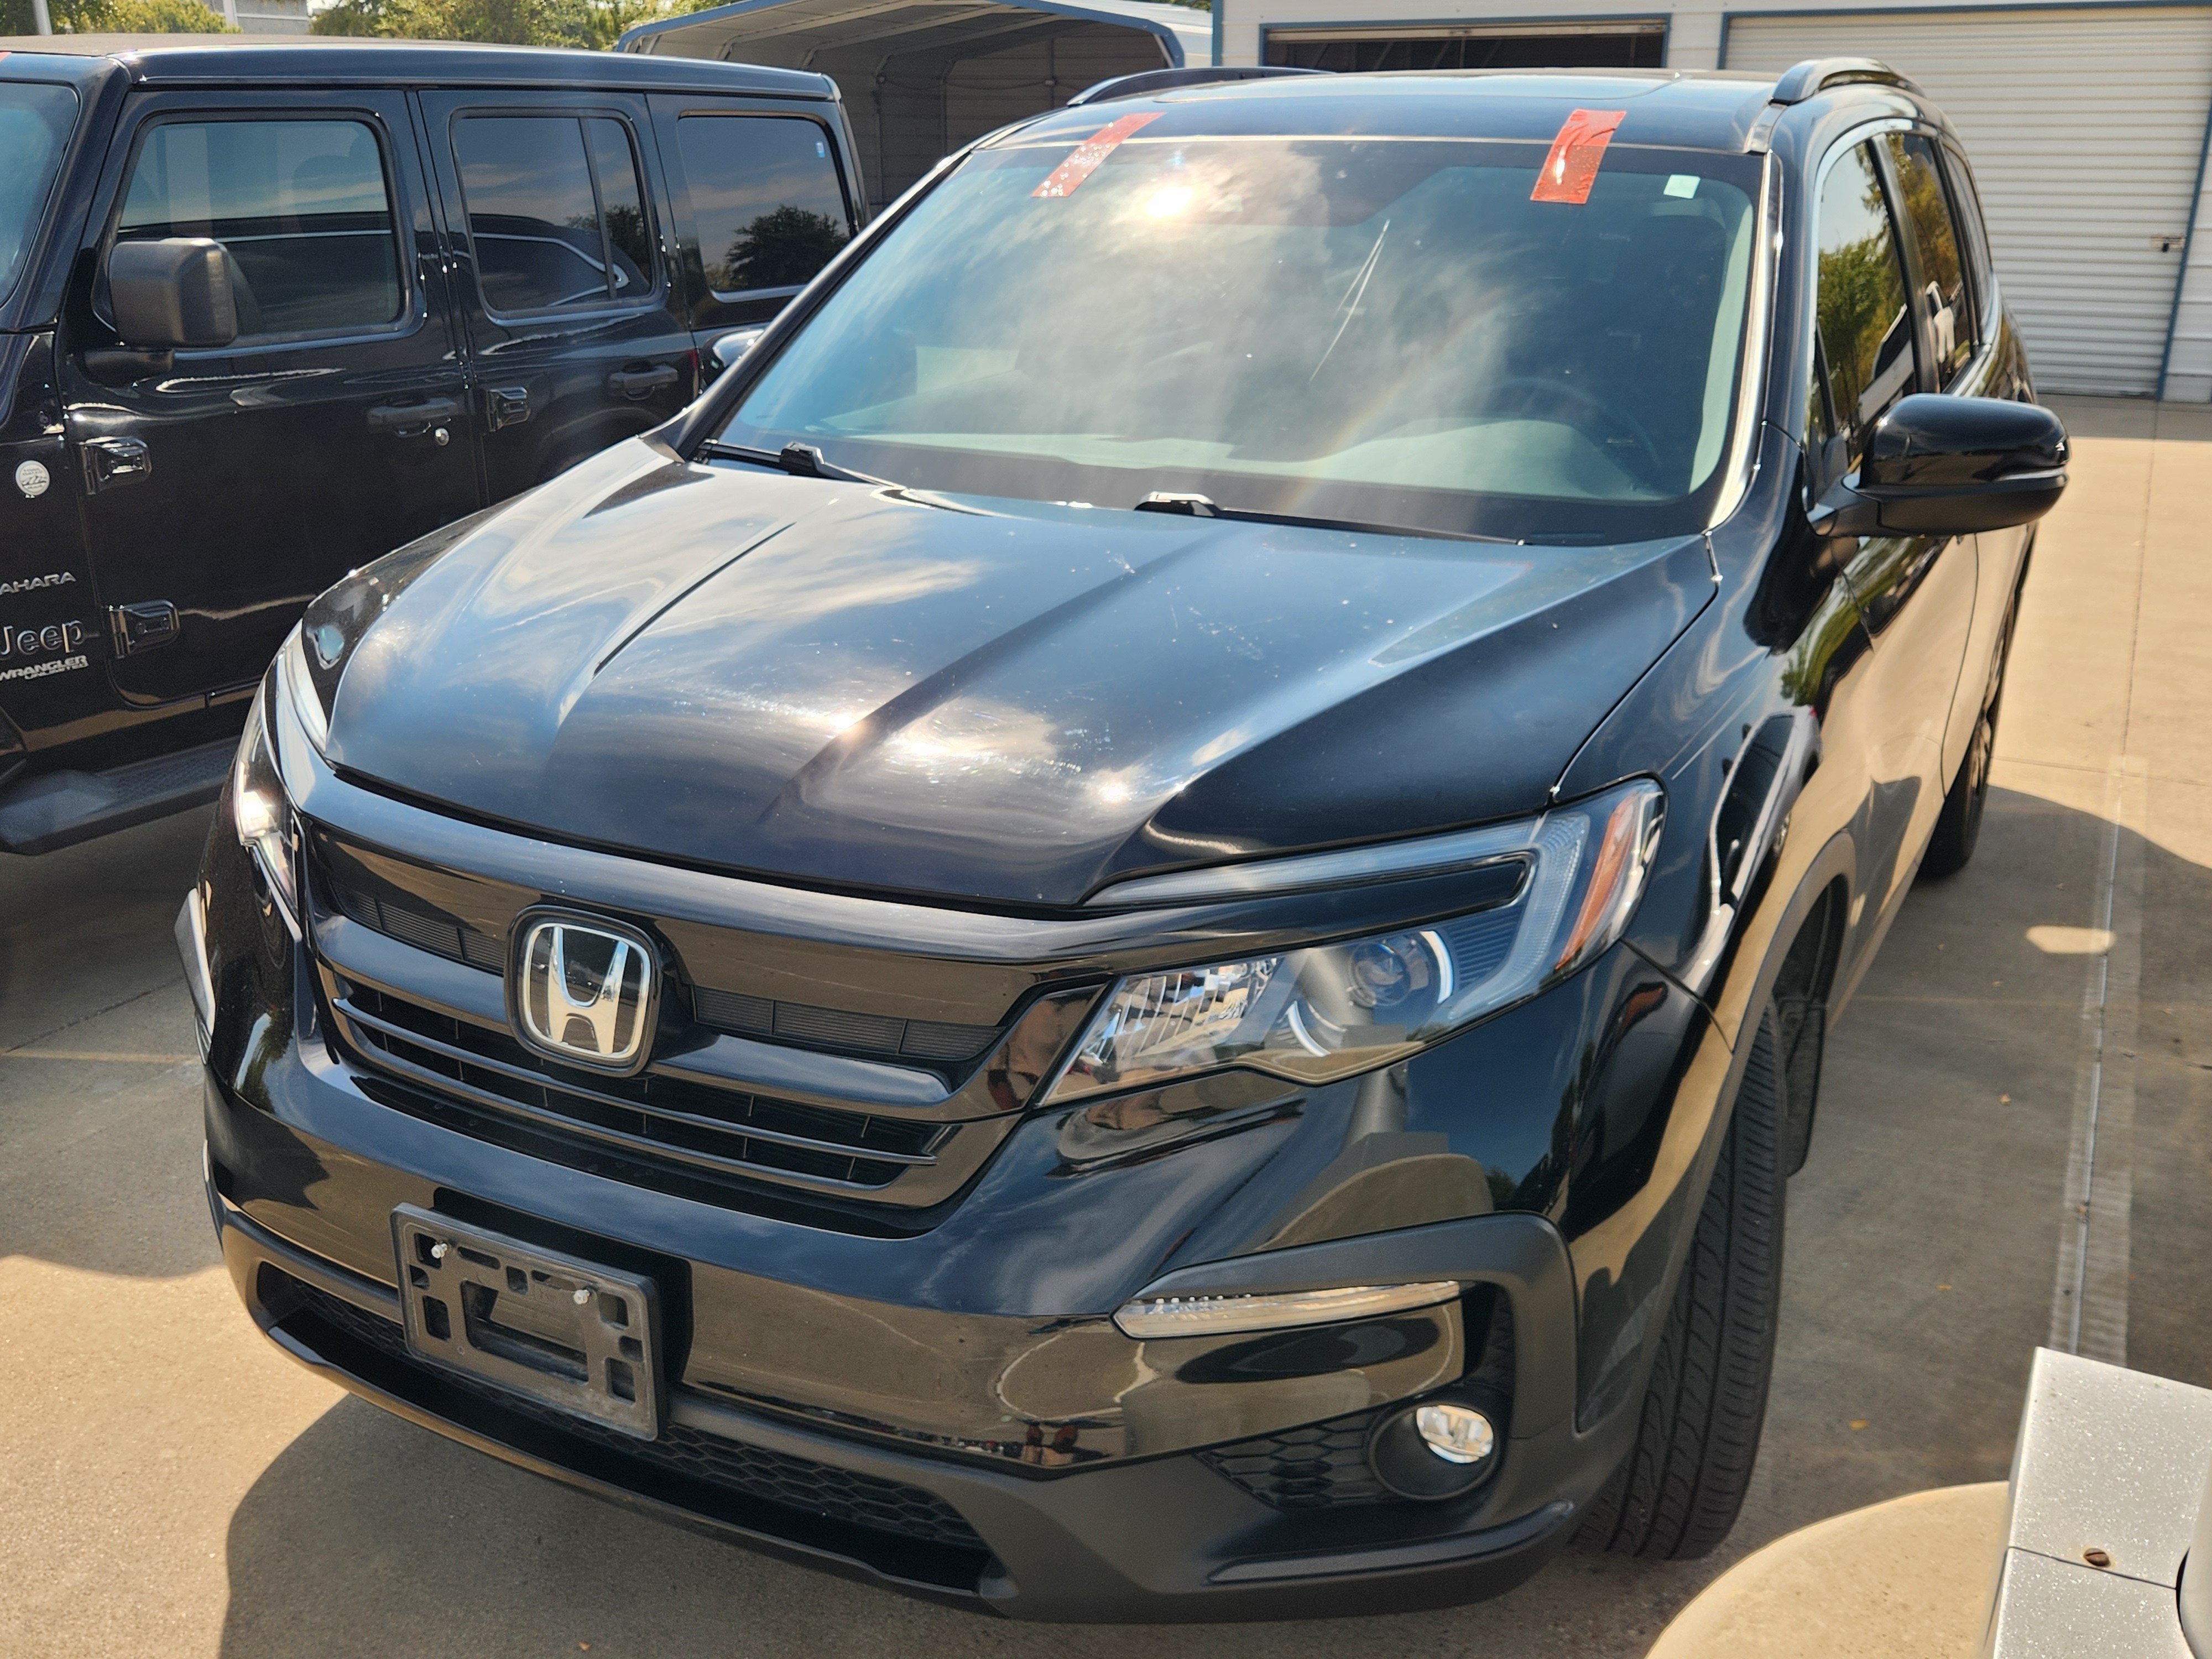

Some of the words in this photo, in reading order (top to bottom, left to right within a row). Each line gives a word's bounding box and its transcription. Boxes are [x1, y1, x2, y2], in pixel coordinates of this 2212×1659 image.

[0, 572, 77, 596] AHARA
[0, 619, 85, 660] Jeep
[0, 655, 88, 681] WRANGLER
